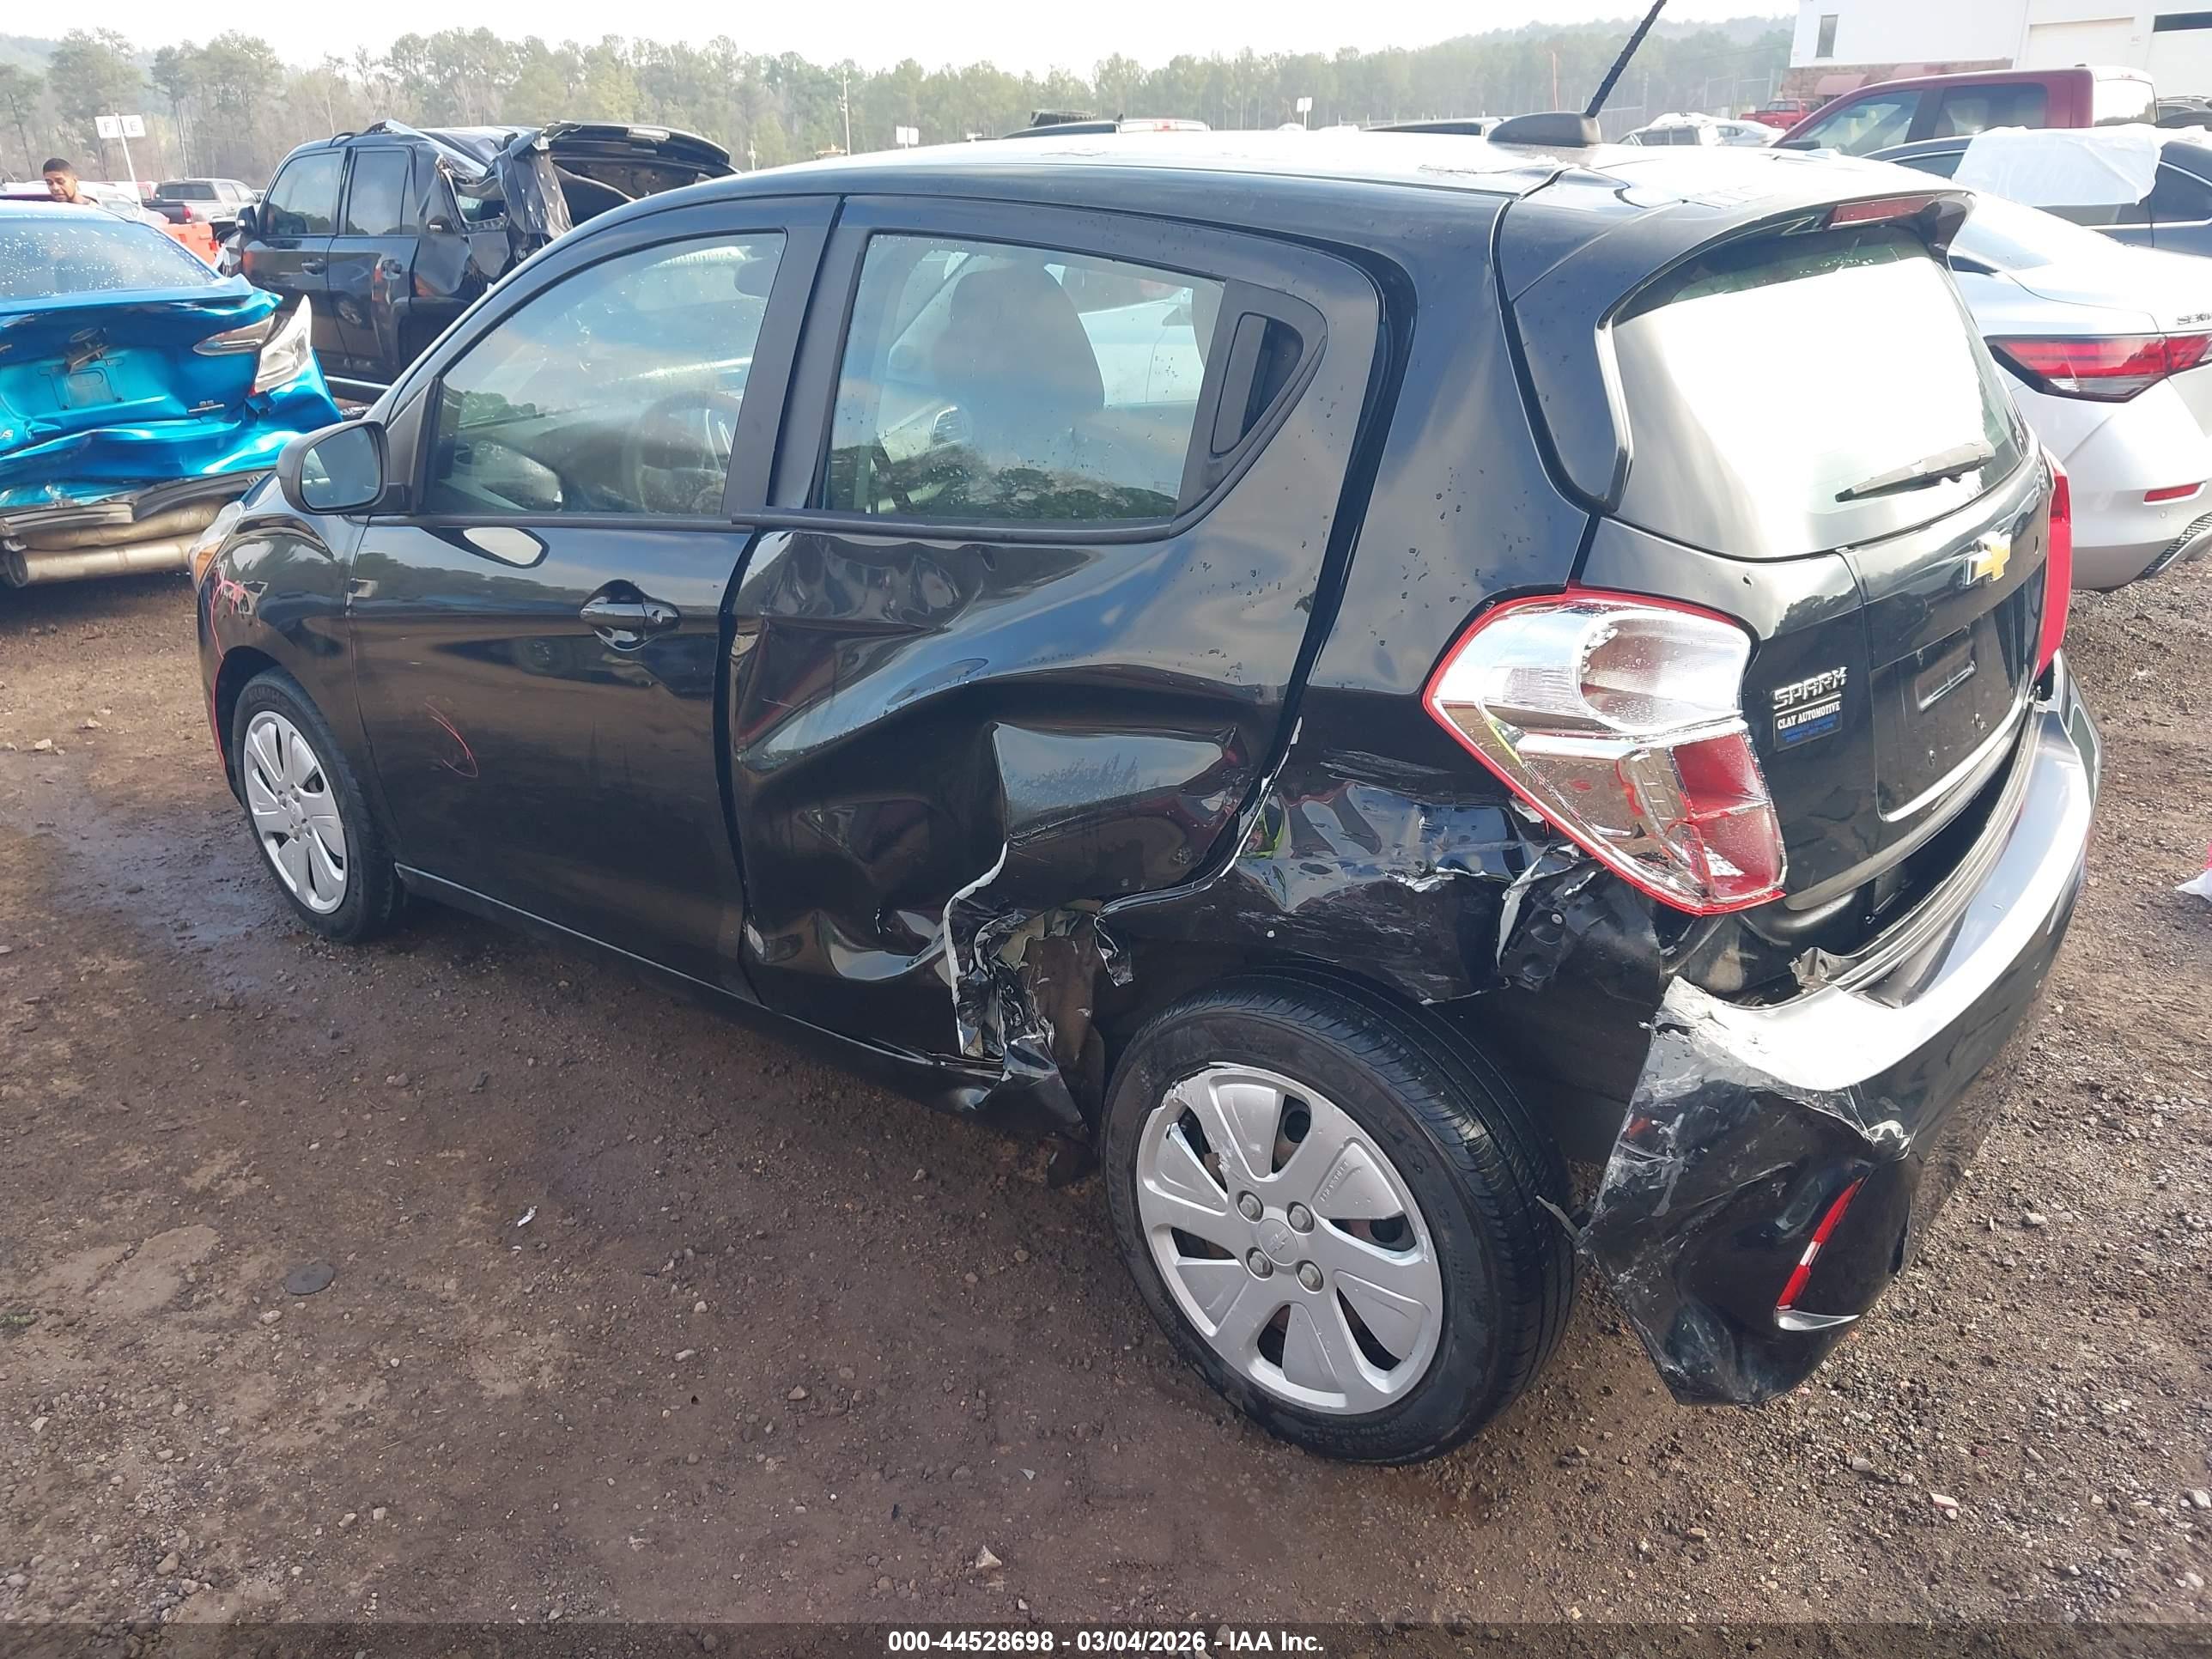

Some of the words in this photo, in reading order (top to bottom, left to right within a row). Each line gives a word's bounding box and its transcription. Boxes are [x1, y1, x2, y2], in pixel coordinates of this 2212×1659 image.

[1773, 666, 1848, 710] SPARK
[1777, 714, 1797, 730] CLAY
[1796, 701, 1841, 724] AUTOMOTIVE
